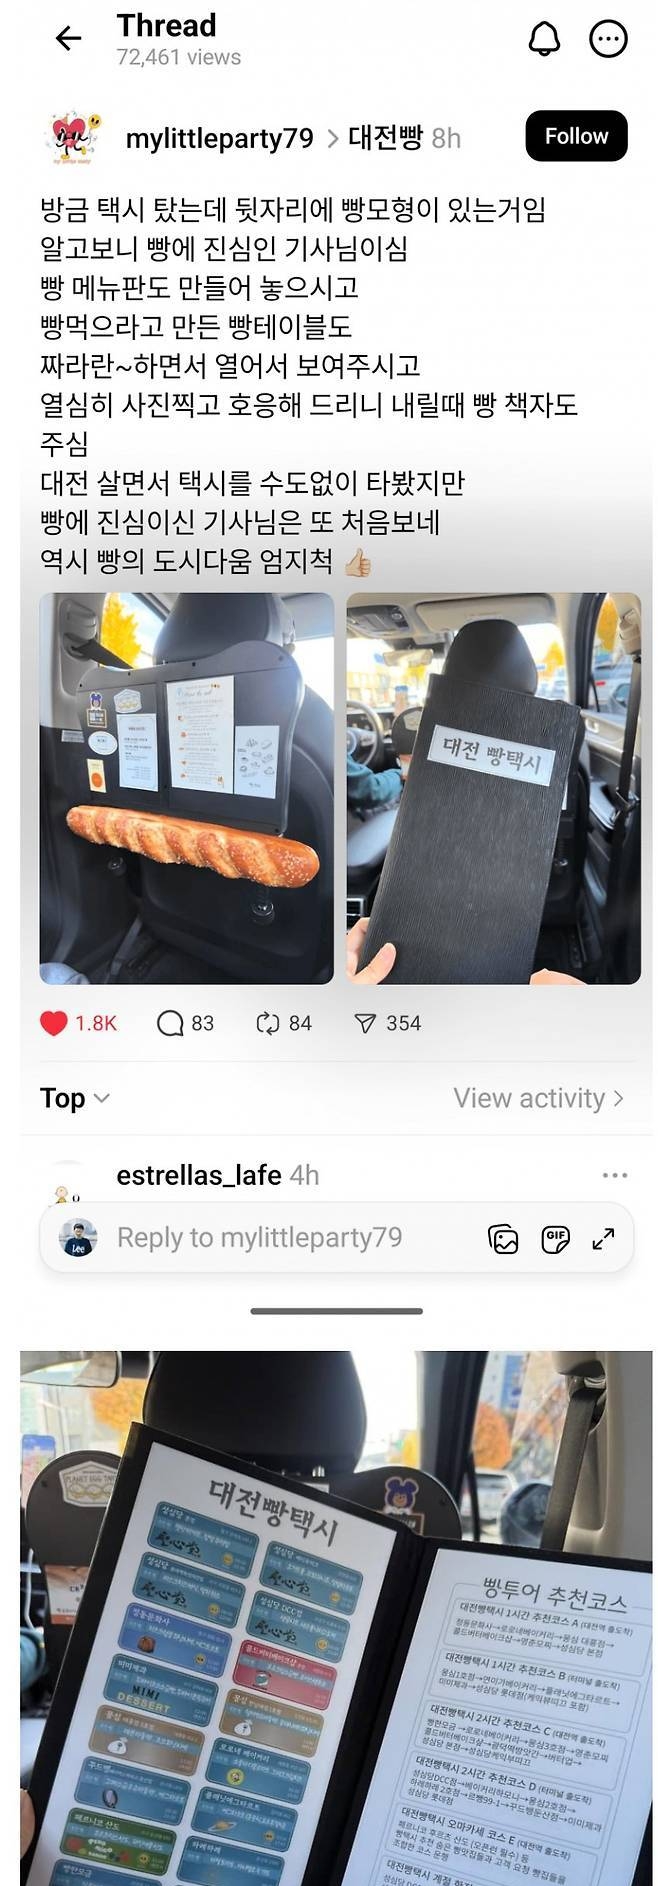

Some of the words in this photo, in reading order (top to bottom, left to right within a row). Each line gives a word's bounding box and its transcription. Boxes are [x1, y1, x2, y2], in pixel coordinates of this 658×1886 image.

[117, 12, 216, 37] Thread
[117, 49, 178, 68] 72,461
[188, 48, 241, 65] views
[127, 126, 313, 154] mylittleparty79
[349, 124, 424, 151] 대전빵
[432, 127, 460, 148] 8h
[545, 127, 609, 146] Follow
[42, 197, 89, 223] 방금
[98, 197, 143, 223] 택시
[155, 197, 225, 223] 탔는데
[236, 197, 332, 223] 뒷자리에
[342, 197, 438, 223] 빵모형이
[449, 197, 544, 223] 있는거임
[41, 236, 136, 262] 알고보니
[148, 236, 194, 262] 빵에
[204, 236, 275, 262] 진심인
[286, 236, 406, 262] 기사님이심
[41, 275, 64, 301] 빵
[73, 275, 170, 301] 메뉴판도
[180, 275, 250, 301] 만들어
[260, 275, 358, 301] 놓으시고
[41, 314, 164, 340] 빵먹으라고
[173, 314, 220, 340] 만든
[229, 314, 352, 340] 빵테이블도
[41, 353, 205, 379] 짜라란~하면서
[216, 353, 286, 379] 열어서
[297, 353, 420, 379] 보여주시고
[41, 392, 112, 418] 열심히
[122, 392, 220, 418] 사진찍고
[228, 392, 300, 418] 호응해
[310, 392, 381, 418] 드리니
[393, 392, 464, 418] 내릴때
[474, 392, 497, 418] 빵
[505, 392, 578, 418] 책자도
[41, 431, 87, 457] 주심
[42, 470, 87, 497] 대전
[97, 470, 168, 497] 살면서
[180, 470, 252, 497] 택시를
[260, 470, 356, 497] 수도없이
[368, 470, 465, 497] 타봤지만
[41, 509, 87, 536] 빵에
[98, 509, 194, 536] 진심이신
[204, 509, 302, 536] 기사님은
[310, 512, 334, 536] 또
[342, 509, 438, 536] 처음보네
[41, 548, 87, 575] 역시
[98, 548, 143, 575] 빵의
[153, 548, 252, 575] 도시다움
[261, 548, 331, 575] 엄지척
[443, 738, 480, 762] 대전
[487, 746, 541, 775] 빵택시
[76, 1015, 117, 1031] 1.8K
[192, 1015, 213, 1031] 83
[289, 1015, 312, 1031] 84
[387, 1015, 421, 1031] 354
[40, 1087, 85, 1114] Top
[454, 1087, 512, 1108] View
[520, 1087, 605, 1114] activity
[117, 1162, 282, 1188] estrellas_lafe
[290, 1164, 318, 1185] 4h
[119, 1226, 183, 1253] Reply
[189, 1228, 213, 1248] to
[222, 1226, 402, 1253] mylittleparty79
[546, 1231, 566, 1240] GIF
[208, 1480, 339, 1547] 대전빵택시
[483, 1577, 541, 1603] 빵투어
[547, 1587, 628, 1614] 추천코스
[460, 1602, 504, 1617] 대전빵택시
[506, 1608, 530, 1621] 1시간
[532, 1613, 569, 1626] 추천코스
[445, 1652, 490, 1668] 대전빵택시
[491, 1660, 516, 1672] 1시간
[518, 1664, 556, 1679] 추천코스
[116, 1692, 172, 1713] DESSERT
[132, 1685, 160, 1701] MIMI
[430, 1704, 475, 1720] 대전빵택시
[476, 1712, 500, 1725] 2시간
[503, 1718, 541, 1734] 추천코스
[416, 1756, 459, 1774] 대전빵택시
[461, 1766, 486, 1779] 2시간
[488, 1772, 526, 1789] 추천코스
[402, 1807, 445, 1826] 대전빵택시
[447, 1819, 485, 1837] 오마카세
[487, 1830, 506, 1843] 코스
[386, 1859, 431, 1880] 대전빵택시
[433, 1872, 450, 1886] 계절
